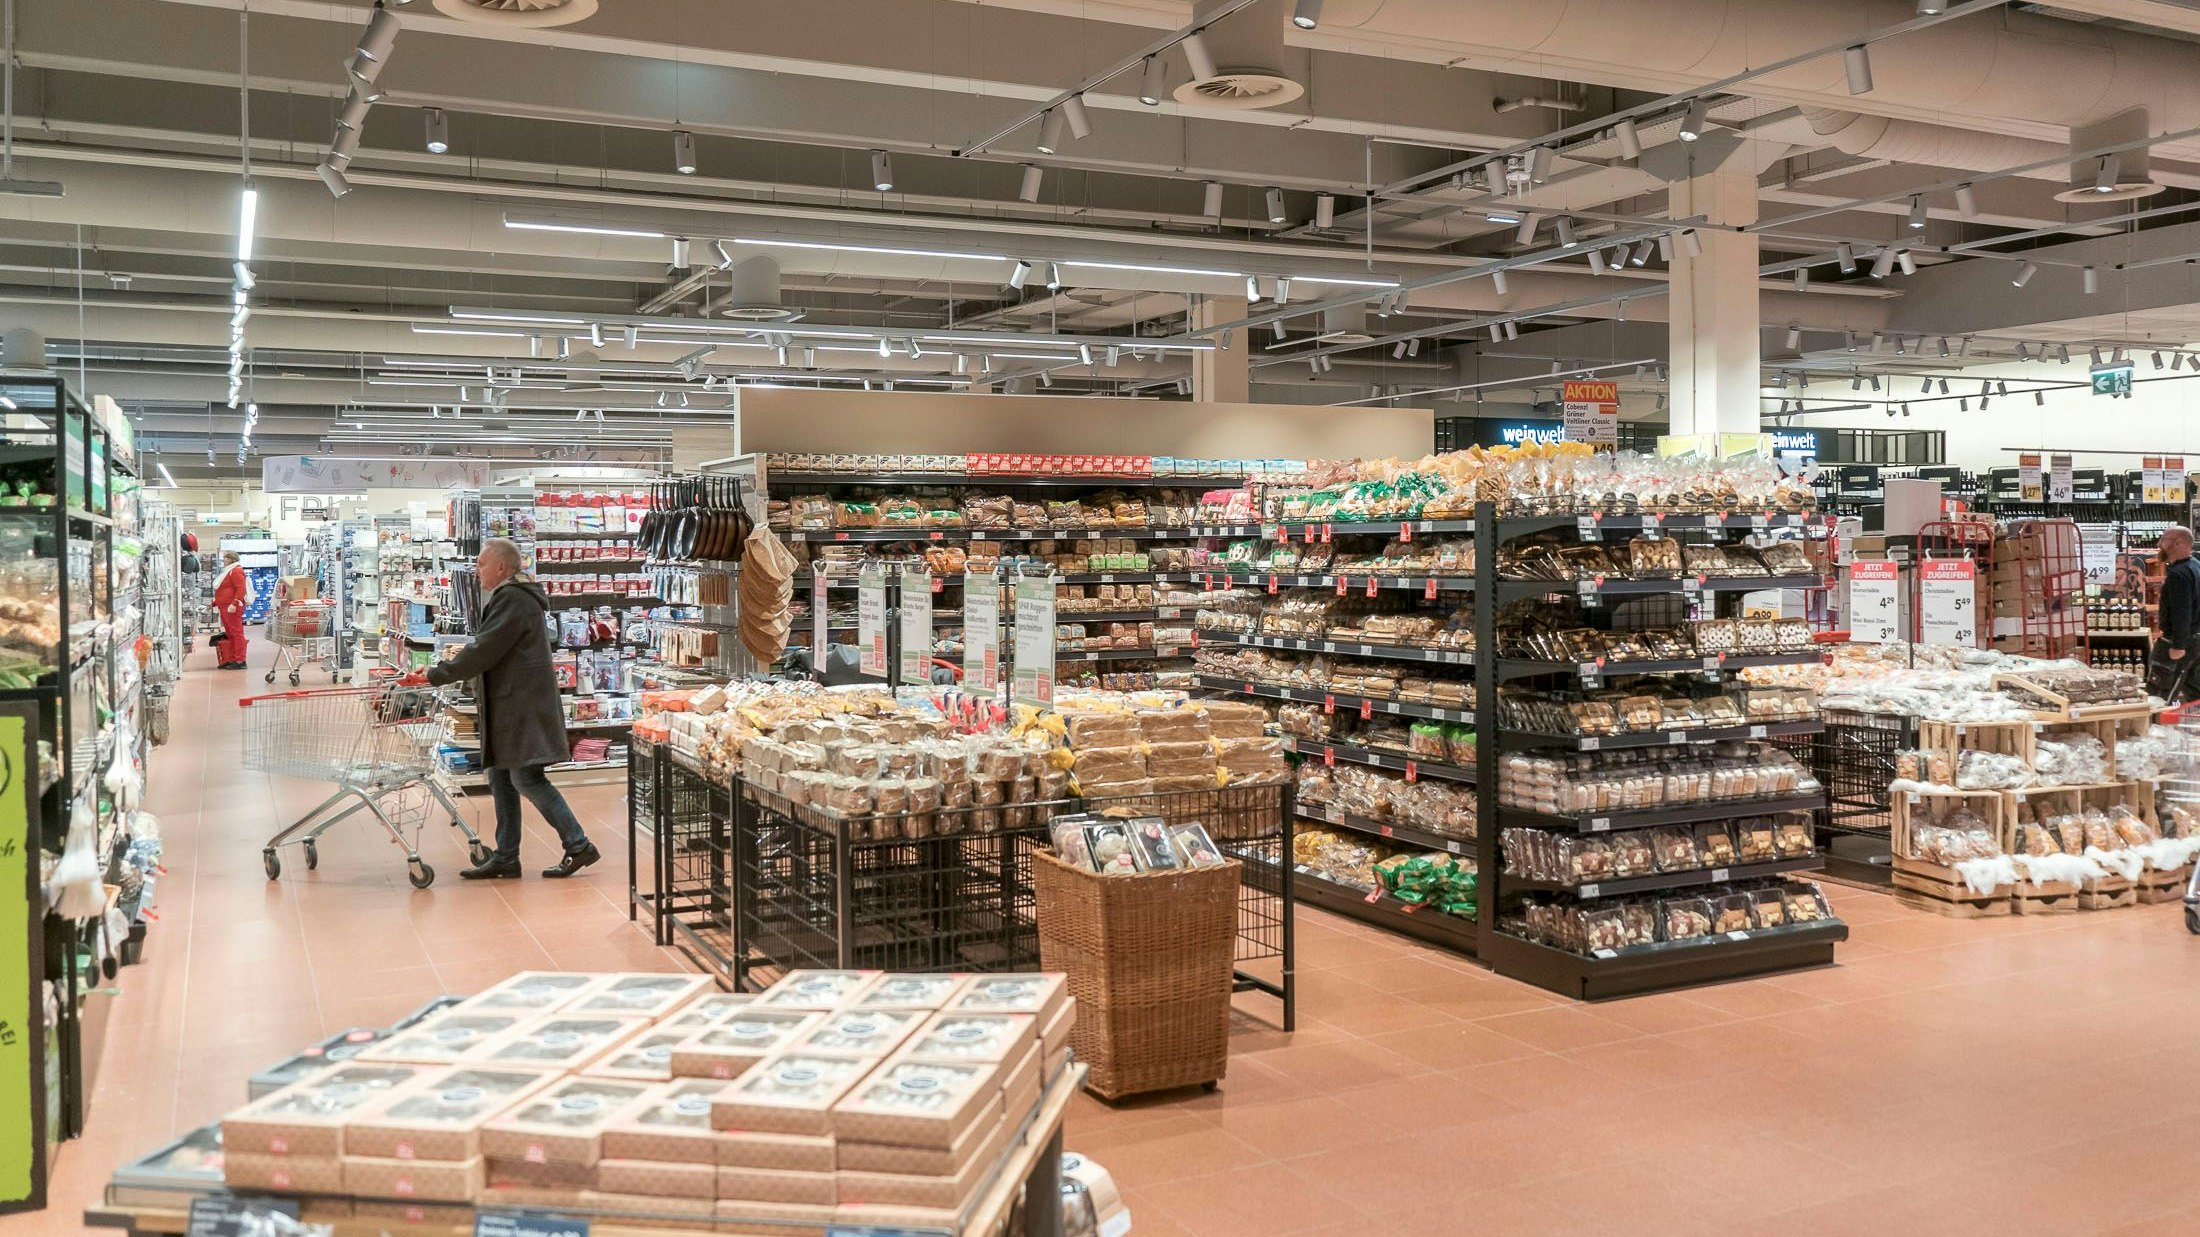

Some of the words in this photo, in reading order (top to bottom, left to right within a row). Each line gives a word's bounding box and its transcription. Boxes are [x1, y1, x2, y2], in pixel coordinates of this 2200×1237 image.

[1565, 384, 1616, 400] AKTION
[1566, 403, 1588, 411] Cobenzl
[1503, 424, 1565, 444] weinwelt
[1864, 563, 1883, 571] JETZT
[1937, 562, 1959, 571] JETZT
[1854, 571, 1893, 579] ZUGREIFEN!
[1926, 571, 1970, 579] ZUGREIFEN!
[1880, 597, 1895, 609] 429
[1954, 598, 1971, 610] 549
[1880, 627, 1895, 639] 399
[1955, 630, 1972, 642] 429
